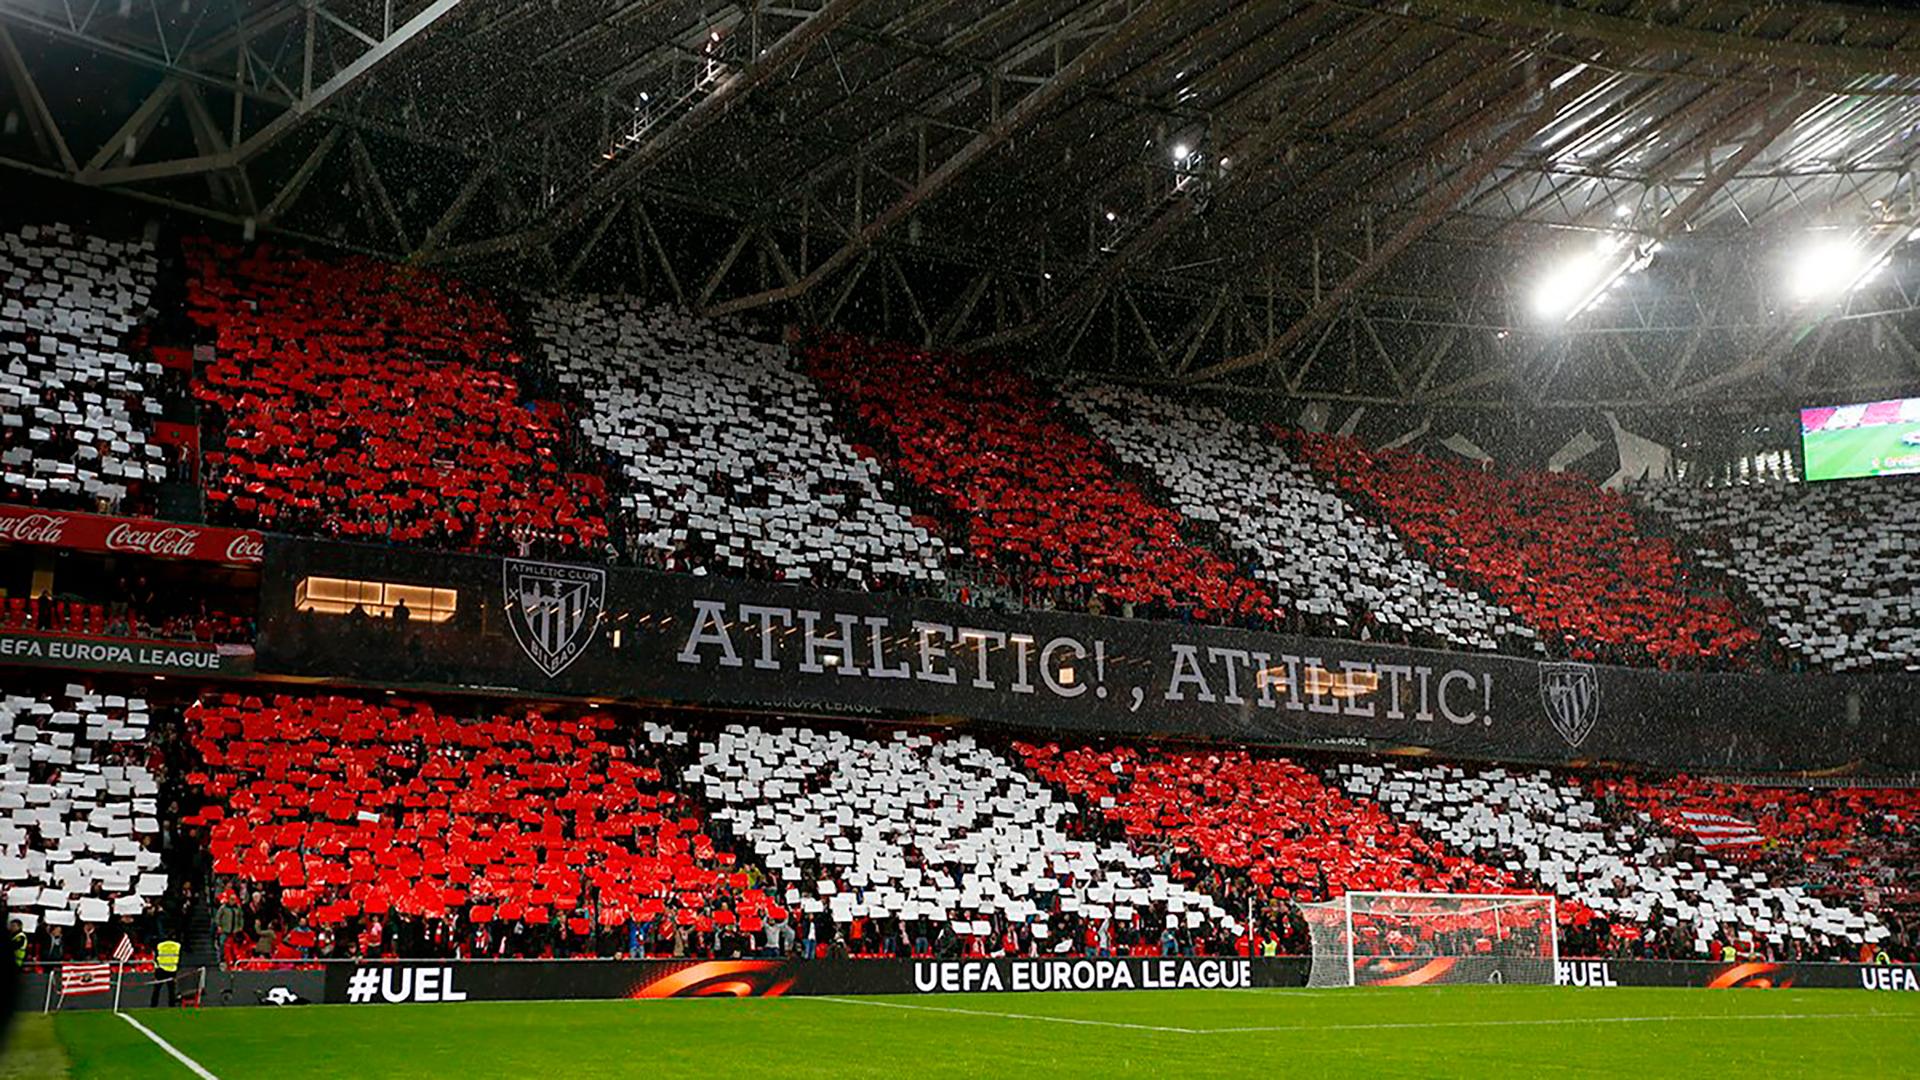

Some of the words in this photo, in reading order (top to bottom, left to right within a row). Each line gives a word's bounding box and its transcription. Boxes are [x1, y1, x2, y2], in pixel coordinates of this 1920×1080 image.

[0, 514, 68, 544] a-Cola
[106, 523, 200, 556] Coca-Cola
[511, 563, 566, 578] ATHLETIC
[567, 569, 599, 581] CLUB
[49, 642, 133, 663] EUROPA
[139, 650, 220, 669] LEAGUE
[530, 640, 576, 671] BILBAO
[1165, 644, 1492, 726] ATHLETIC!
[347, 967, 467, 1003] #UEL
[914, 962, 1002, 991] UEFA
[1012, 961, 1134, 990] EUROPA
[1142, 960, 1251, 988] LEAGUE
[1556, 961, 1617, 987] #UEL
[1861, 967, 1920, 991] UEFA
